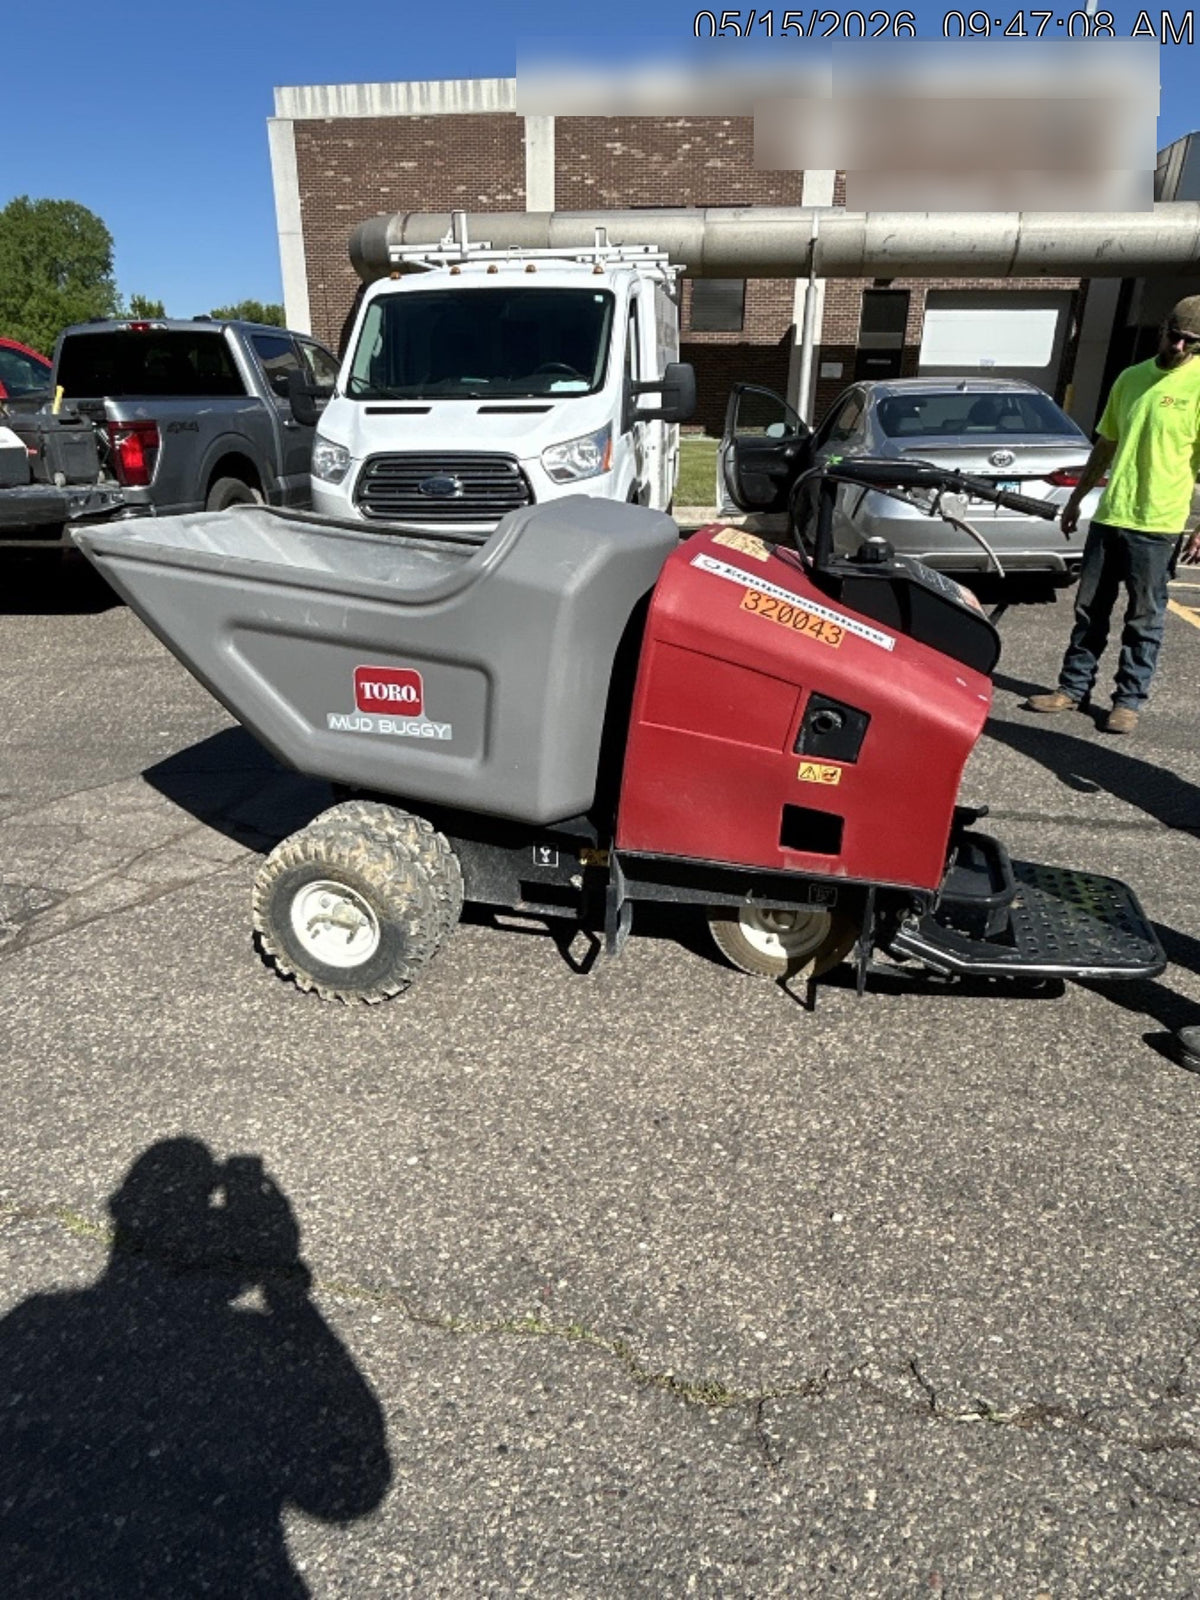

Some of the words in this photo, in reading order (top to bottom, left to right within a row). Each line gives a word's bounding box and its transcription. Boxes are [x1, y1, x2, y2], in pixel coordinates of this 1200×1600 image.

[744, 590, 844, 646] 320043
[328, 715, 373, 731] MUD
[379, 719, 448, 739] BUGGY
